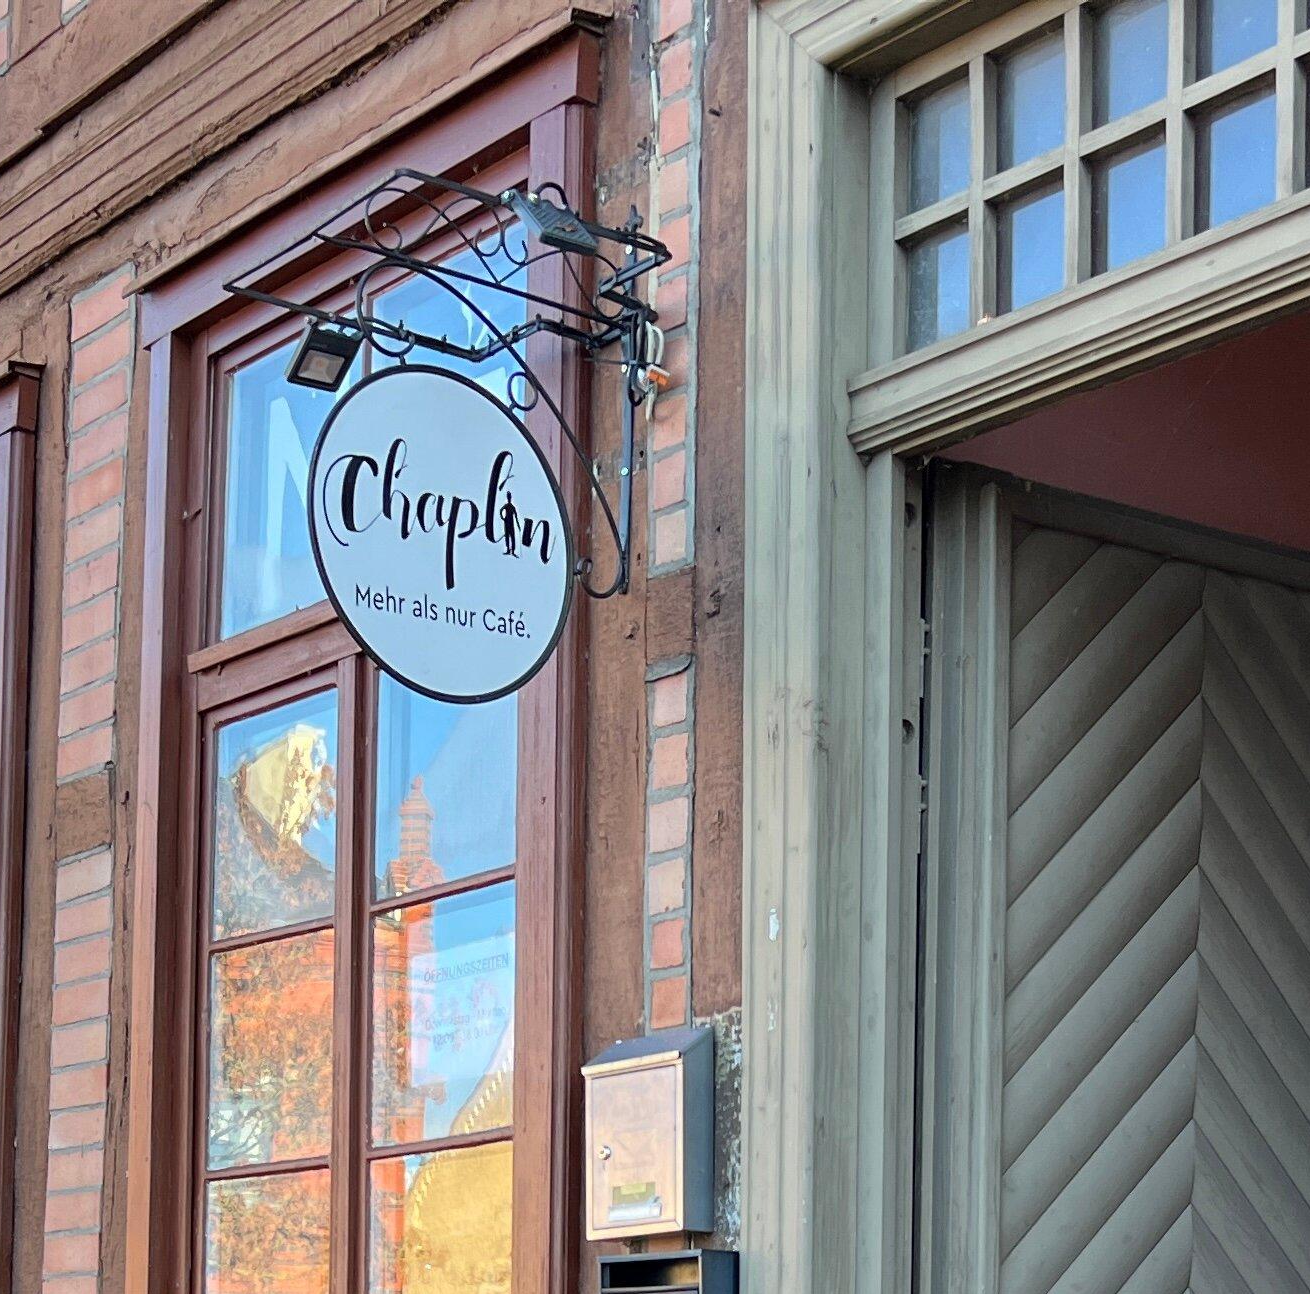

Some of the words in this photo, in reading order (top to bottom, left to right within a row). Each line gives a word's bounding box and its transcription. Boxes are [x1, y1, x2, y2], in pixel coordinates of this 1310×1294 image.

[323, 438, 556, 590] Chaplin
[354, 583, 405, 615] Mehr
[412, 593, 438, 621] als
[445, 604, 477, 627] nur
[482, 606, 532, 640] Café.
